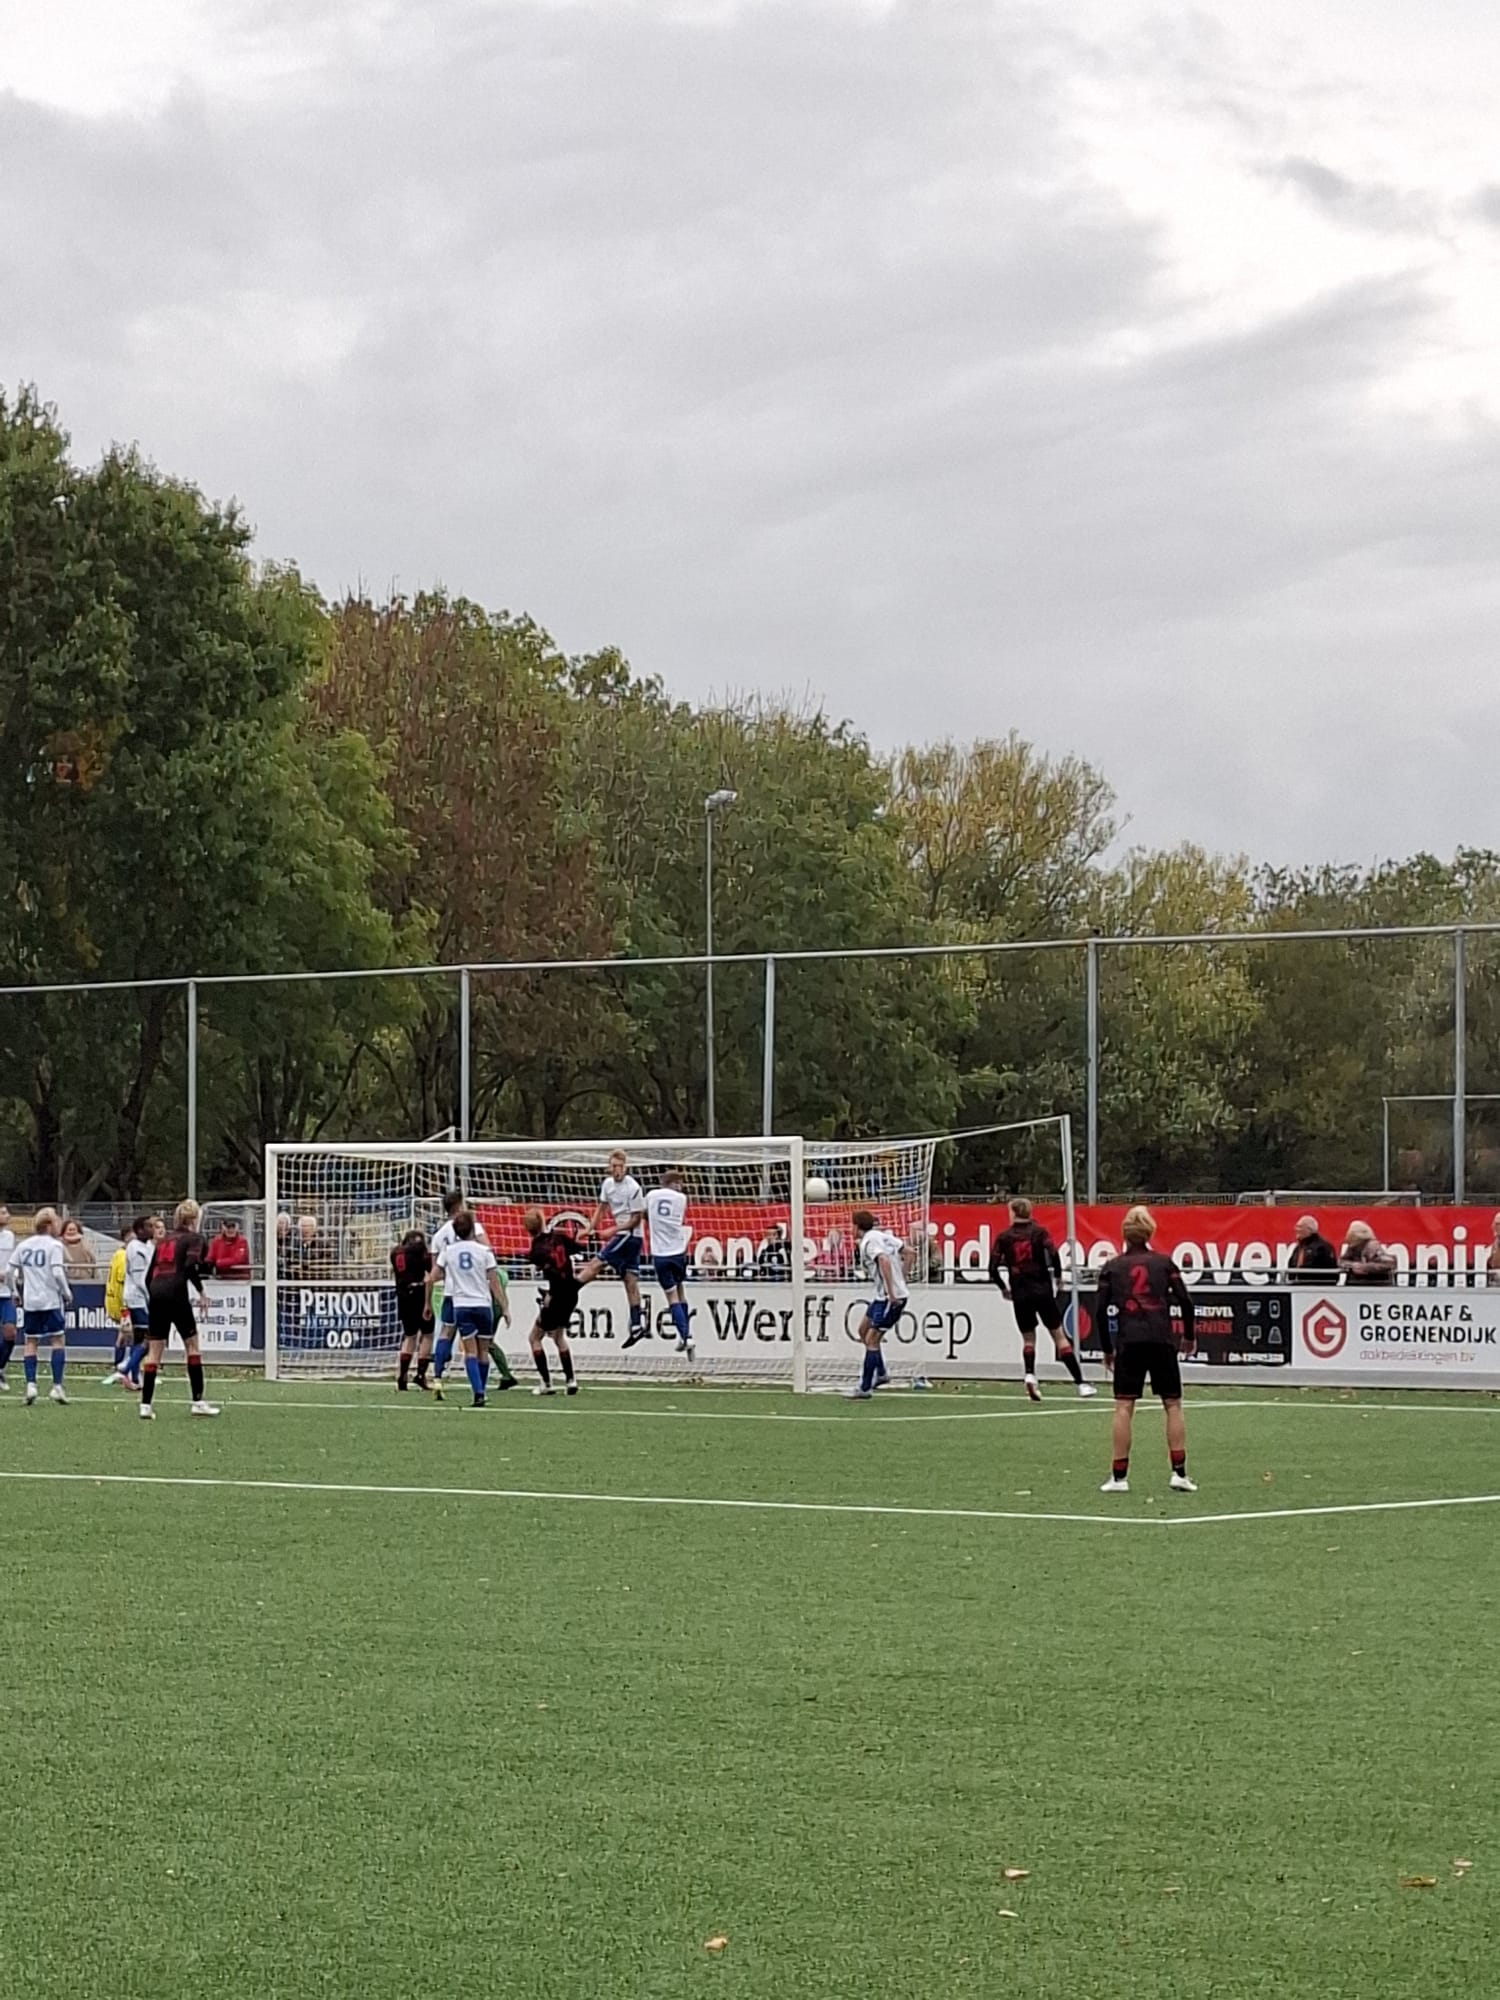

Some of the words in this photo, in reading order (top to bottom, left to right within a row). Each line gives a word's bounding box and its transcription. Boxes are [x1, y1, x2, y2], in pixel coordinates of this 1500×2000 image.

[657, 1199, 673, 1217] 6
[21, 1248, 46, 1268] 20
[458, 1251, 473, 1270] 8
[1129, 1264, 1150, 1295] 2
[300, 1288, 380, 1316] PERONI
[1359, 1303, 1382, 1320] DE
[1387, 1304, 1453, 1321] GRAAF
[1459, 1304, 1473, 1321] &
[707, 1295, 834, 1342] Werff
[844, 1298, 972, 1360] Goep
[1360, 1325, 1497, 1344] GROENENDIJK
